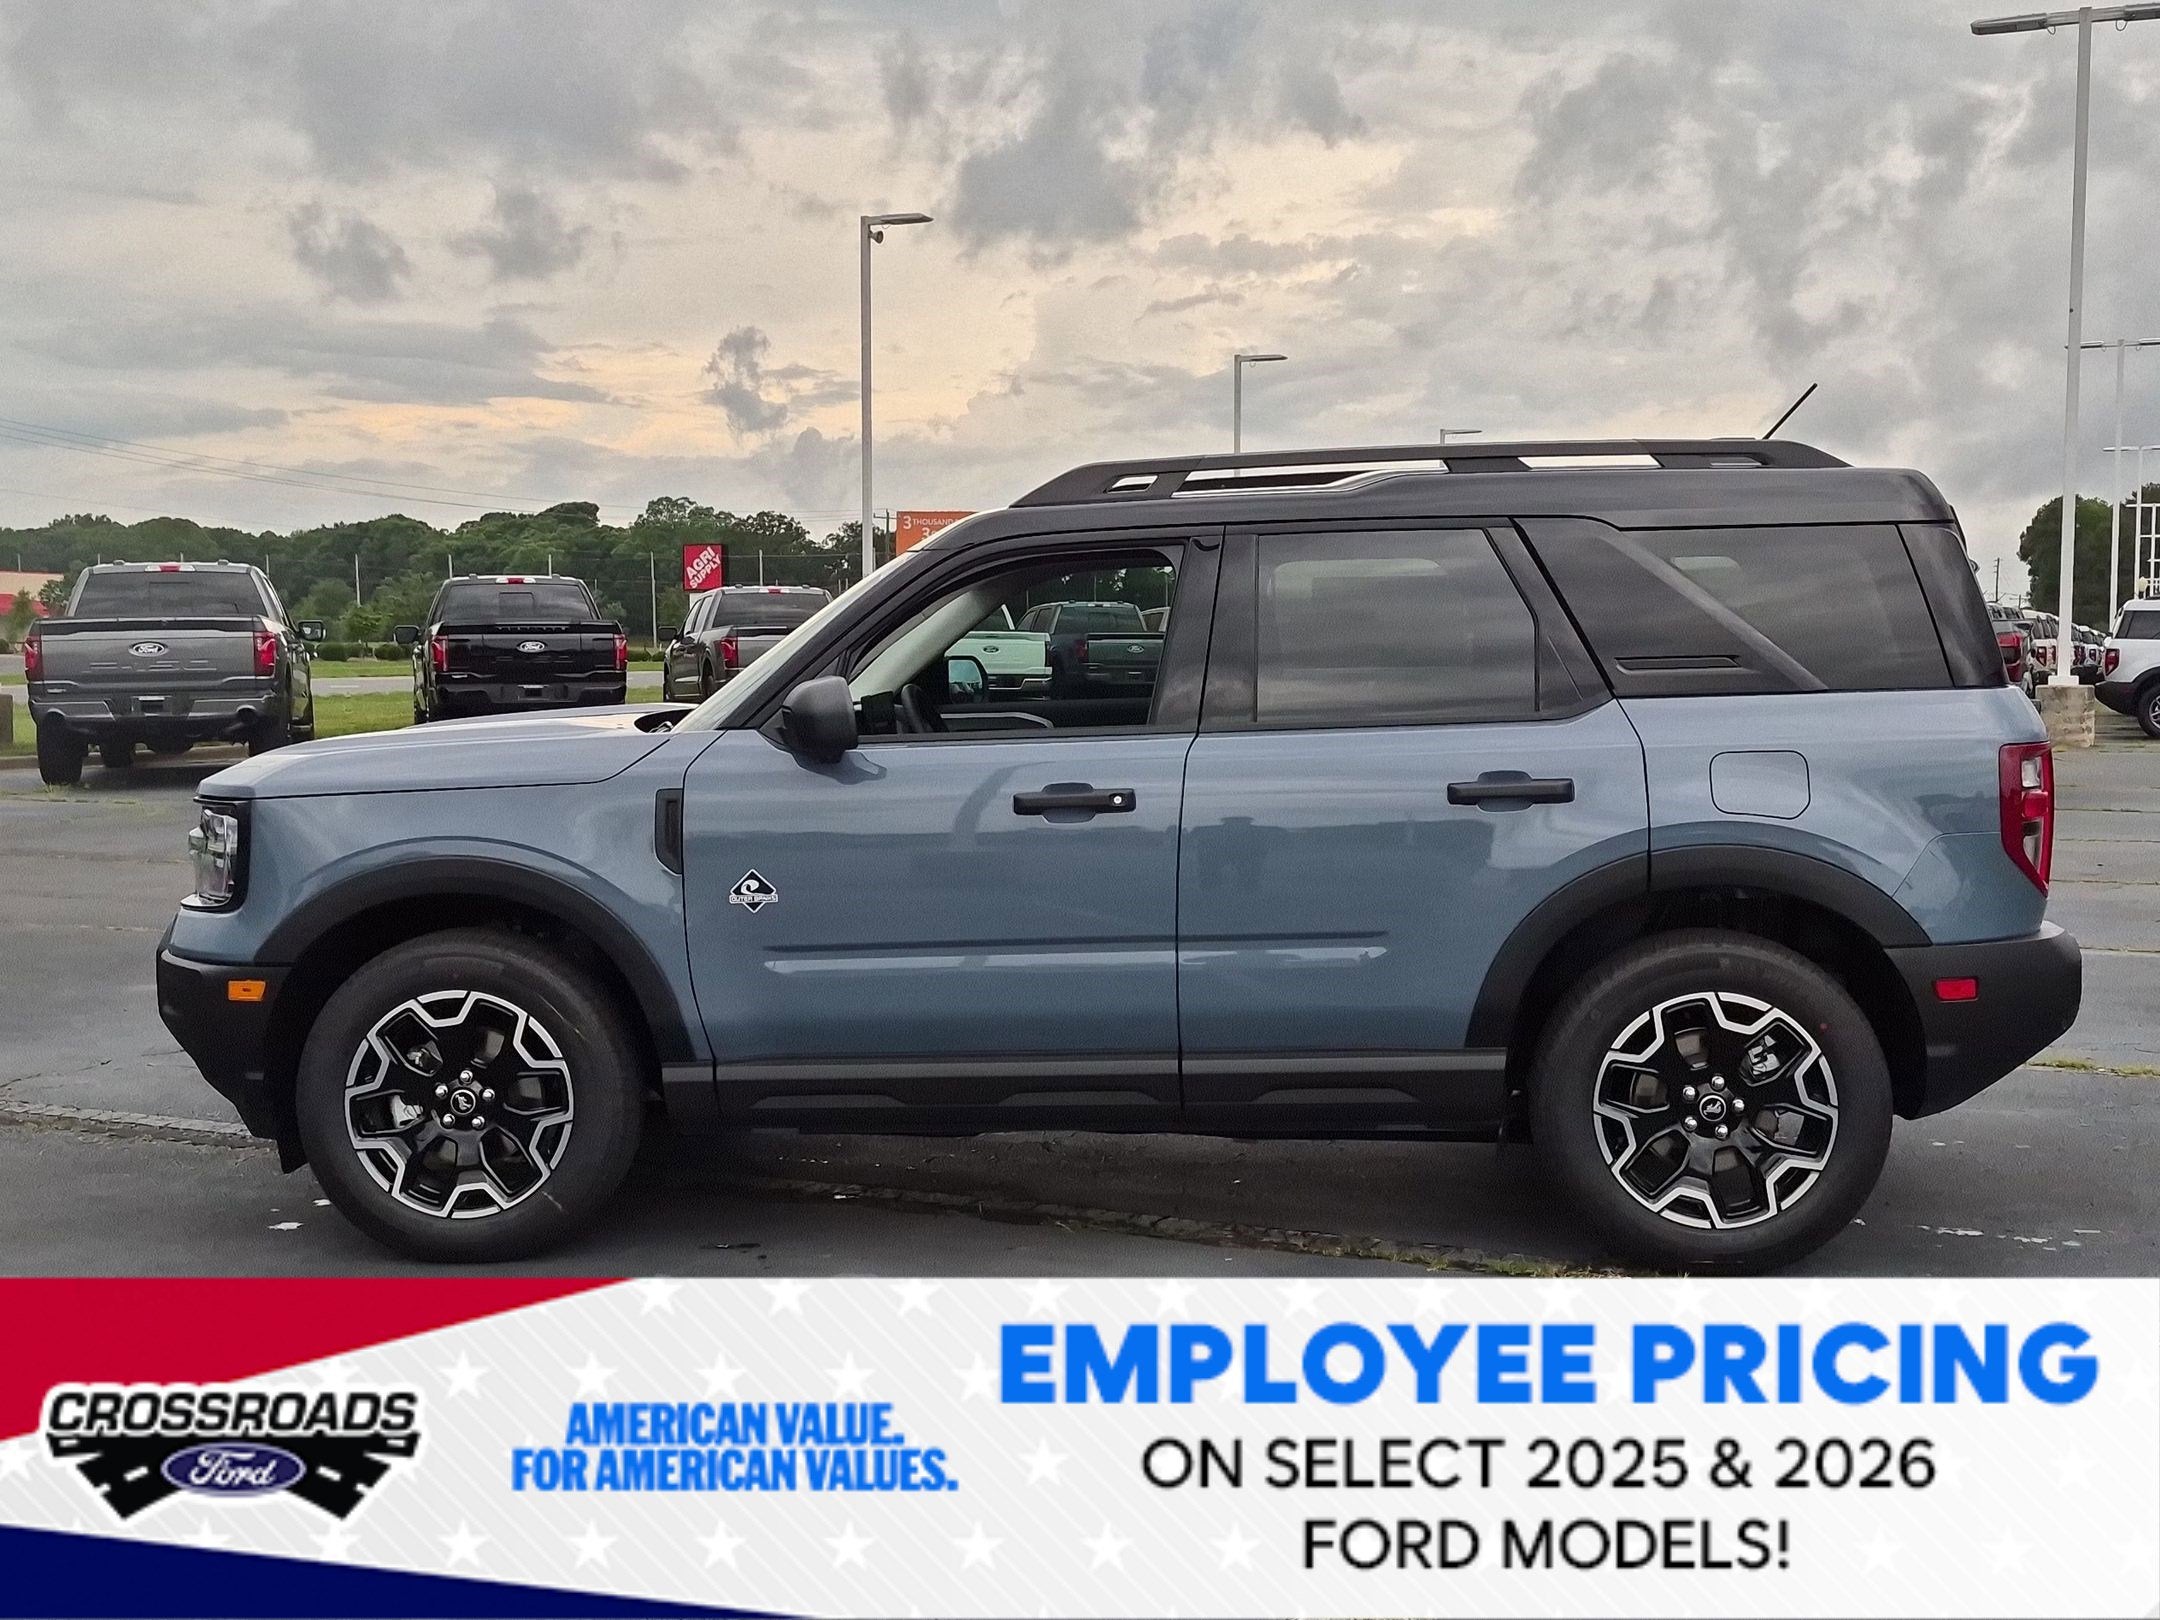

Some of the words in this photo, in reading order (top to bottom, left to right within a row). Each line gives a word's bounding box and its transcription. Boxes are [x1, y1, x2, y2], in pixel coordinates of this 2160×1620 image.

[903, 515, 912, 529] 3
[913, 518, 954, 526] THOUSAND
[686, 546, 715, 580] AGRI
[690, 554, 721, 588] SUPPLY
